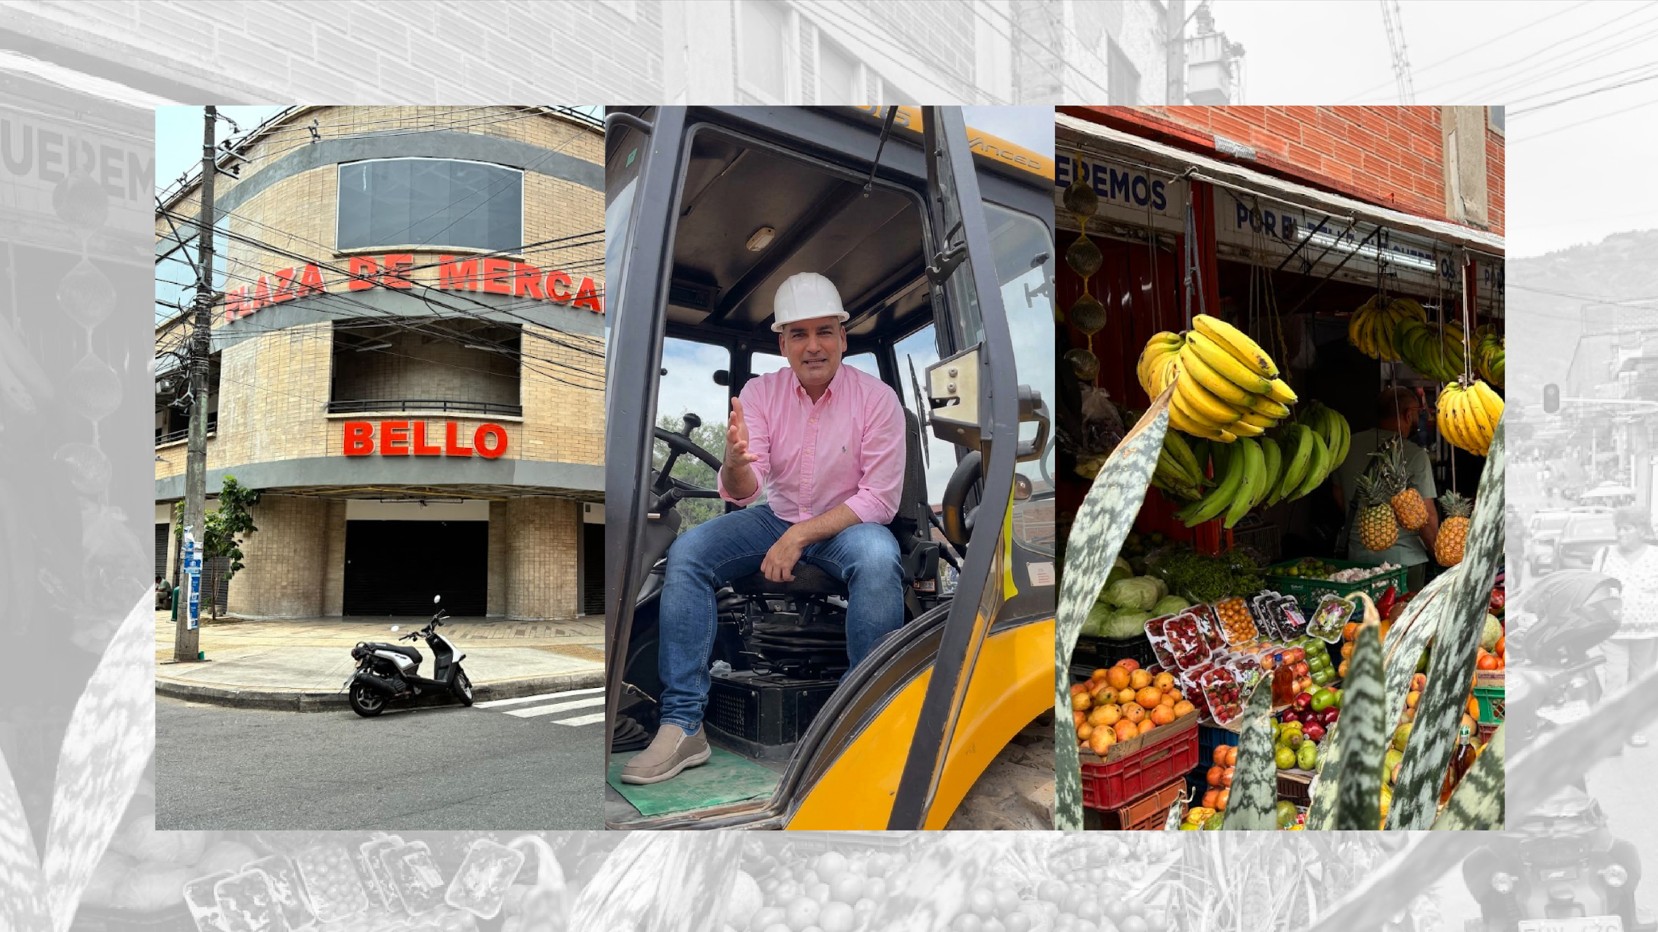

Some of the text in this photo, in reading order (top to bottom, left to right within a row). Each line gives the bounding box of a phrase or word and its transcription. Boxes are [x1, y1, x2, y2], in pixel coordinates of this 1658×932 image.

[225, 249, 606, 323] PLAZA DE MERCA
[343, 420, 509, 460] BELLO
